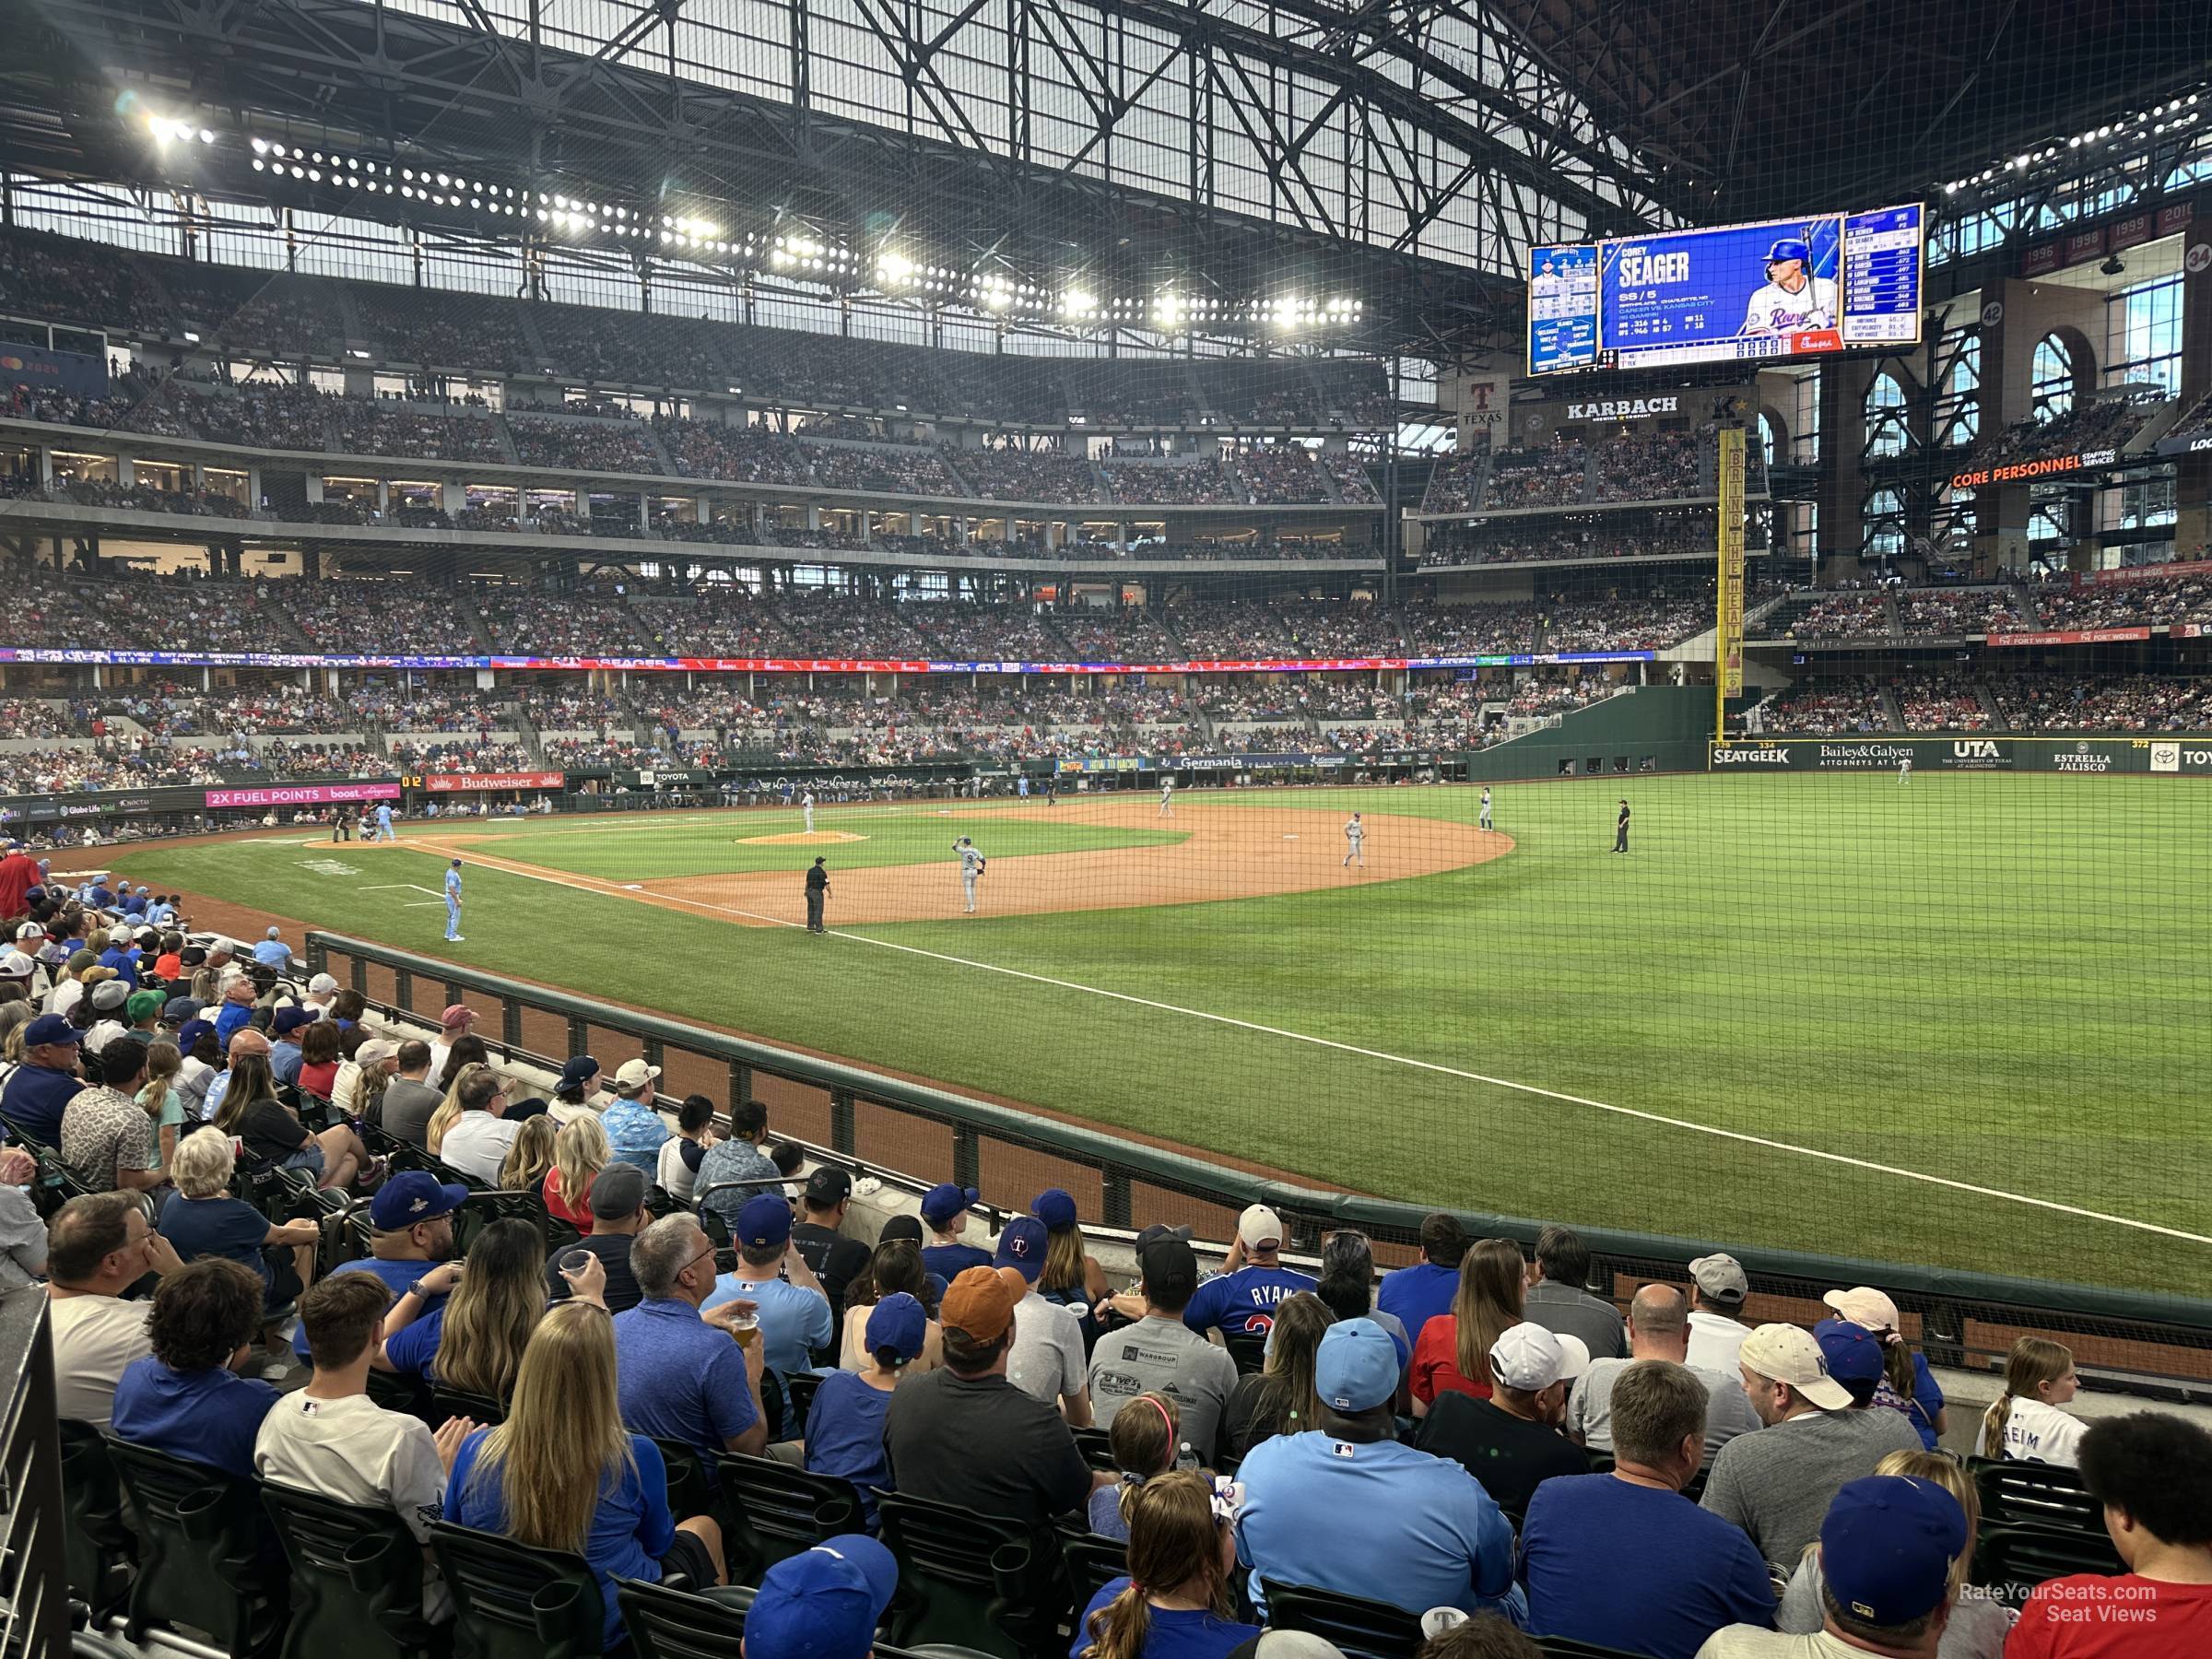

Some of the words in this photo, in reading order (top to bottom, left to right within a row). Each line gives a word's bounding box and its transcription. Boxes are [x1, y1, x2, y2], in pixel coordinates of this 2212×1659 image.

[2116, 218, 2145, 234] 1999
[2072, 231, 2099, 250] 1998
[1622, 246, 1647, 257] COREY
[2028, 245, 2053, 263] 1996
[2190, 249, 2210, 267] 34
[1619, 252, 1689, 288] SEAGER
[1619, 291, 1638, 301] SS
[1647, 290, 1656, 299] 5
[1619, 305, 1650, 314] CAREER
[1664, 301, 1696, 311] KANSAS
[1983, 305, 2001, 322] 42
[1471, 382, 1494, 410] T
[1567, 396, 1677, 419] KARBACH
[1464, 413, 1502, 425] TEXAS
[2082, 449, 2116, 461] STAFFING
[2083, 456, 2115, 467] SERVICES
[1952, 471, 1989, 488] CORE
[1993, 455, 2081, 482] PERSONNEL
[1732, 453, 1740, 528] BRING
[1730, 532, 1739, 573] THE
[2128, 570, 2141, 578] THE
[1730, 581, 1738, 637] HEAT
[2036, 636, 2061, 644] WORTH
[2112, 632, 2139, 641] WORTH
[1803, 641, 1832, 649] SHIFT
[599, 658, 666, 666] SEAGER
[1954, 741, 2000, 758] UTA
[2132, 740, 2149, 748] 372
[1713, 748, 1790, 764] SEATGEEK
[1819, 745, 1913, 759] Bailey&Galyen
[1089, 759, 1105, 770] HOW
[1107, 759, 1115, 770] TO
[1117, 759, 1138, 769] NACHO
[1181, 757, 1241, 769] Germania
[1819, 759, 1872, 767] ATTORNEYS
[2054, 754, 2112, 763] ESTRELLA
[2058, 763, 2106, 771] JALISCO
[402, 777, 409, 787] 0
[412, 777, 421, 787] 12
[462, 776, 533, 789] Budweiser
[211, 793, 229, 805] 2X
[233, 791, 267, 803] FUEL
[272, 790, 319, 801] POINTS
[69, 806, 88, 814] Globe
[88, 805, 100, 813] Life
[100, 804, 115, 812] Field
[967, 854, 973, 864] 9
[1014, 1239, 1025, 1252] T
[1139, 1351, 1177, 1363] WARGROUP
[1433, 1611, 1456, 1630] T
